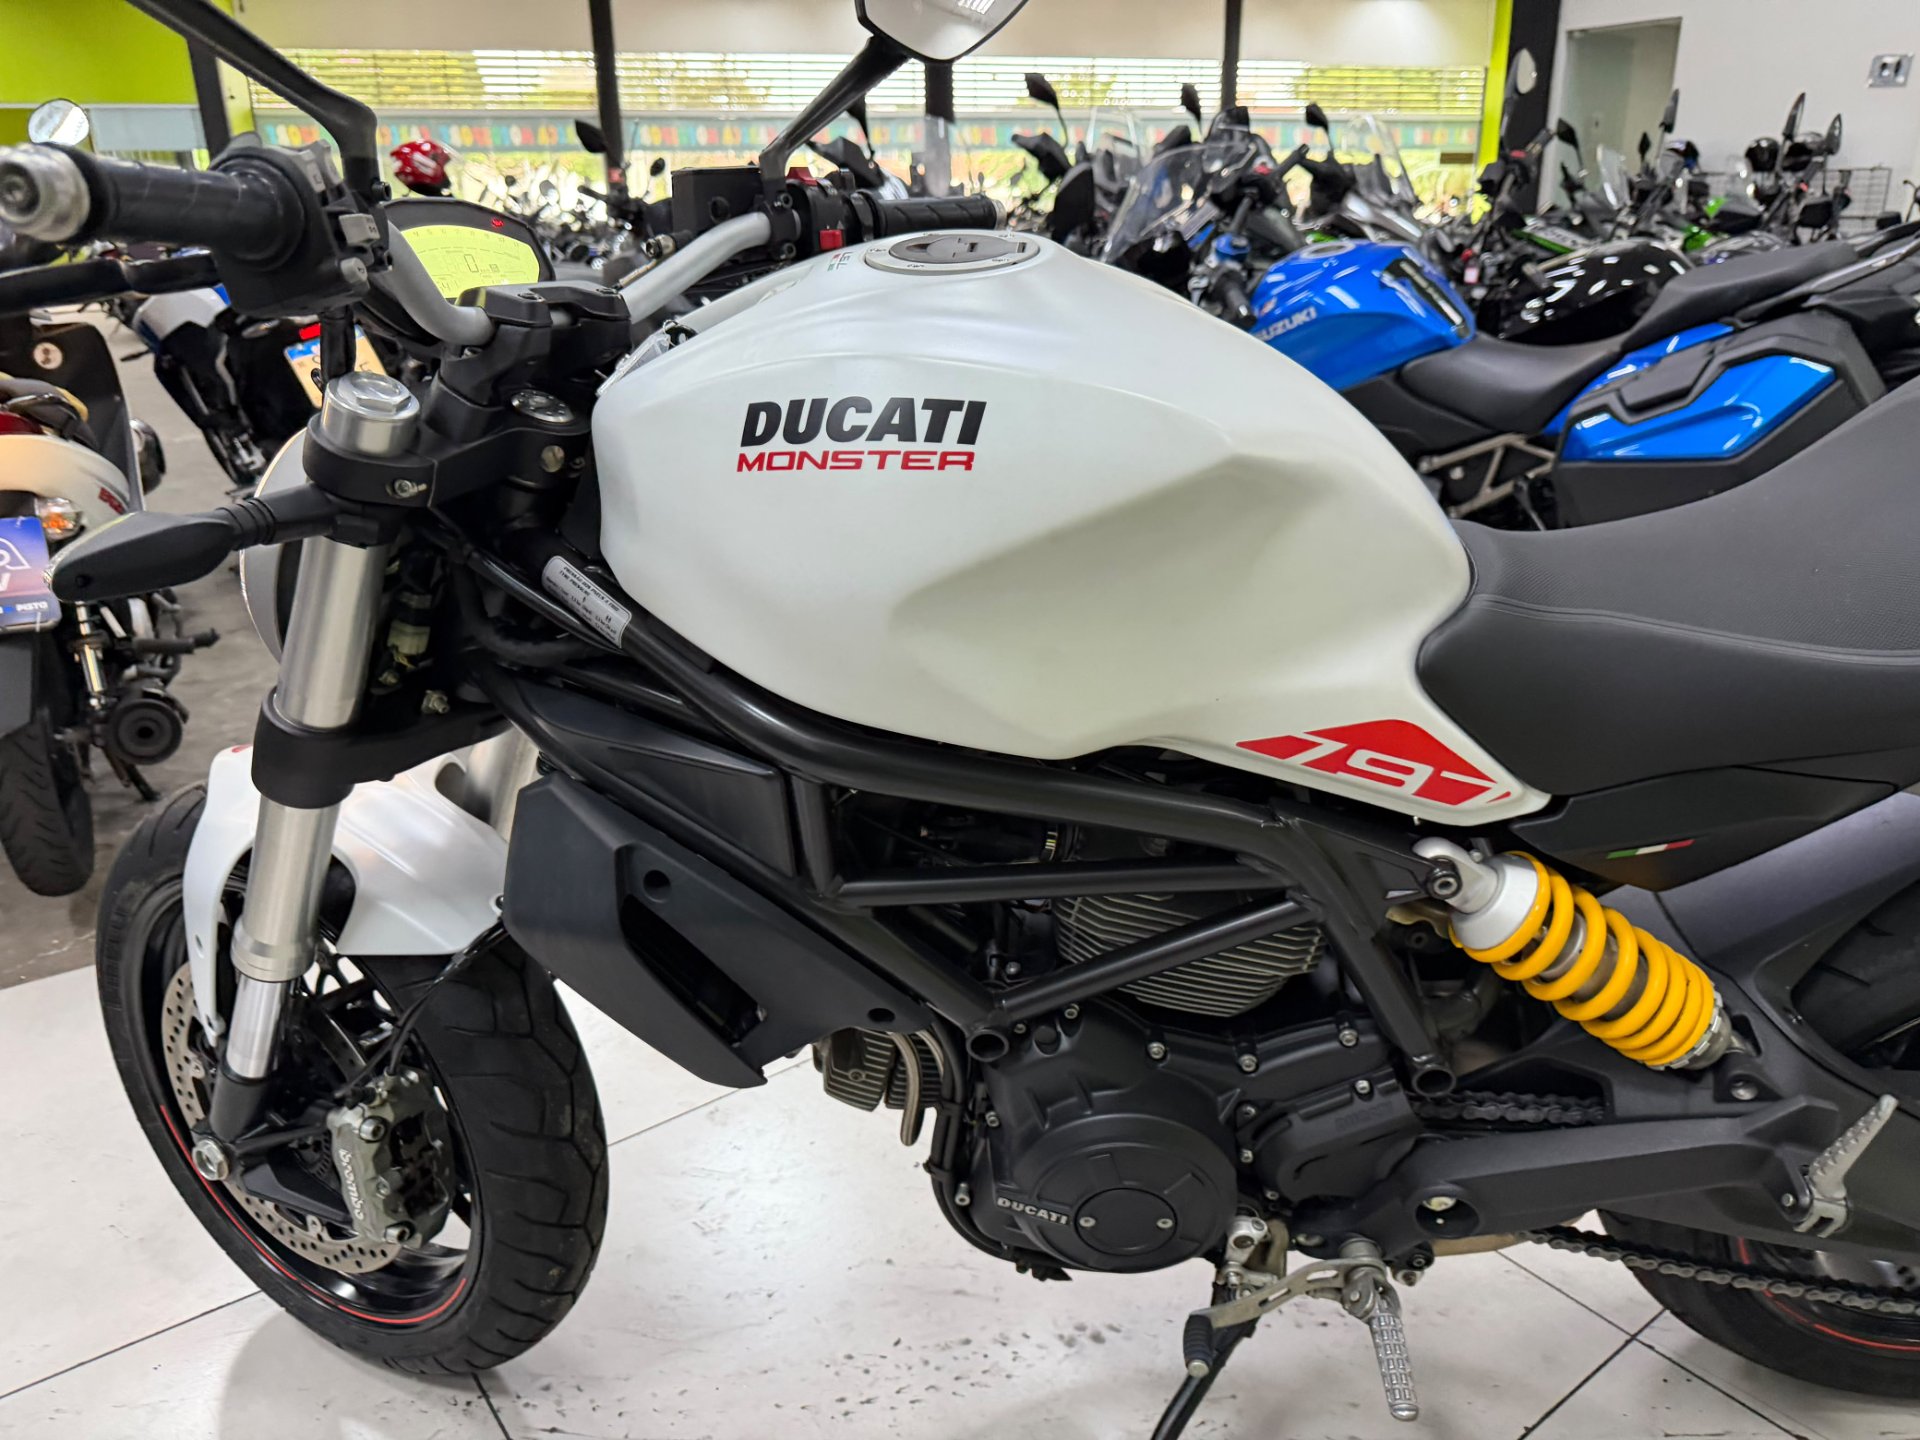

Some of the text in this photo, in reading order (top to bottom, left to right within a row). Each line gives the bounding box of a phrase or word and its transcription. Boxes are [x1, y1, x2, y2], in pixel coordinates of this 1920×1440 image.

[741, 396, 987, 447] DUCATI
[737, 450, 975, 472] MONSTER
[1283, 733, 1500, 806] 797
[338, 1148, 364, 1220] brembo
[997, 1197, 1068, 1225] DUCATI
